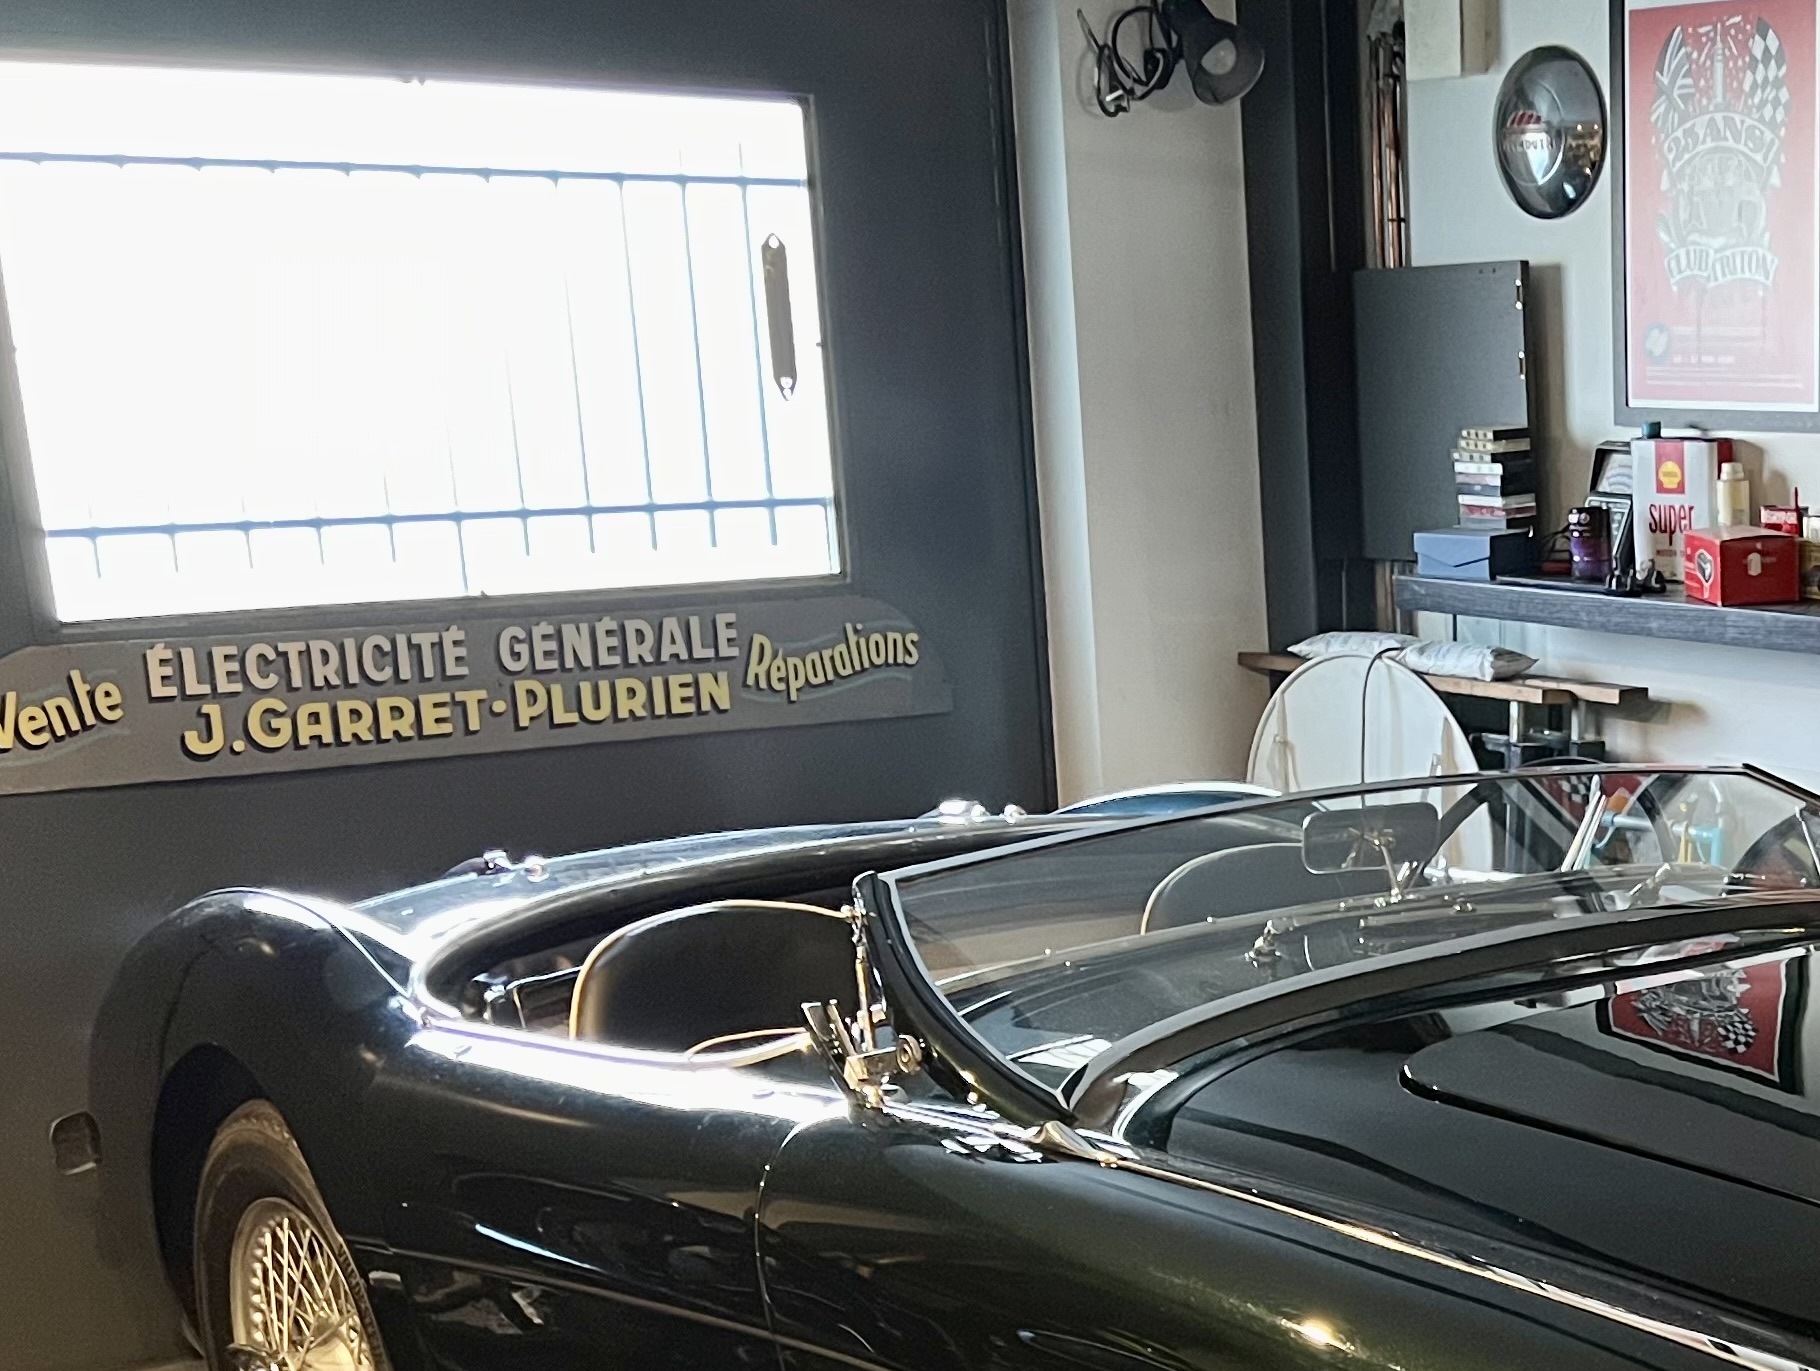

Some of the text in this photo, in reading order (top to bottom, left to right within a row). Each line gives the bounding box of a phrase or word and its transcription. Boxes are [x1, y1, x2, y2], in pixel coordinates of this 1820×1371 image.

[1648, 503, 1695, 547] super
[145, 612, 741, 699] ÉLECTRICITÉ GÉNÉRALE
[746, 622, 920, 702] Réparations
